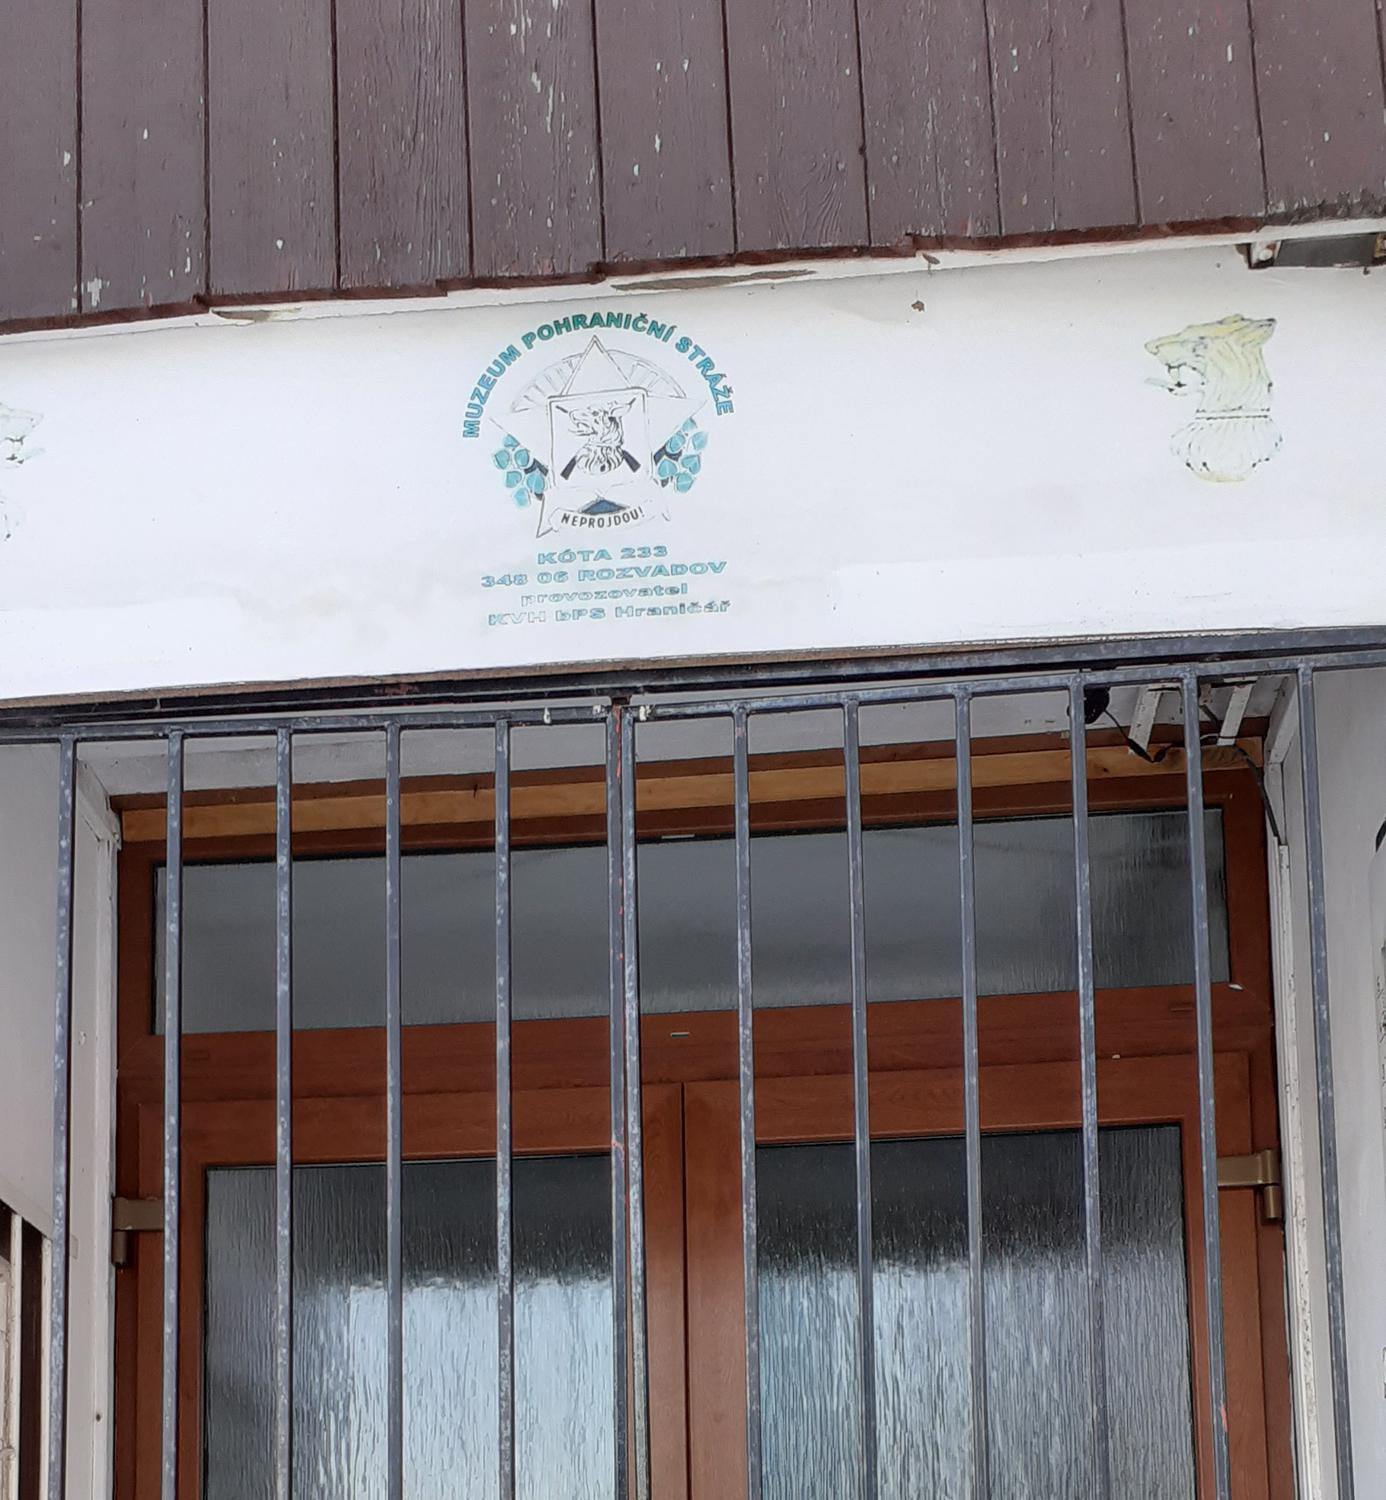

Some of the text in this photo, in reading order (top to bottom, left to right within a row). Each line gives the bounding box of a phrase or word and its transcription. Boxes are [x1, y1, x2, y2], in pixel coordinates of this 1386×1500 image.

[462, 311, 734, 438] MUZEUM POHRANIČNÍ STRÁŽE
[560, 506, 644, 529] NEPROJDOU!
[537, 545, 668, 565] KÓTA 233
[481, 561, 727, 588] 348 06 ROZVADOV
[520, 583, 688, 607] provozovatel
[488, 611, 546, 626] KVH
